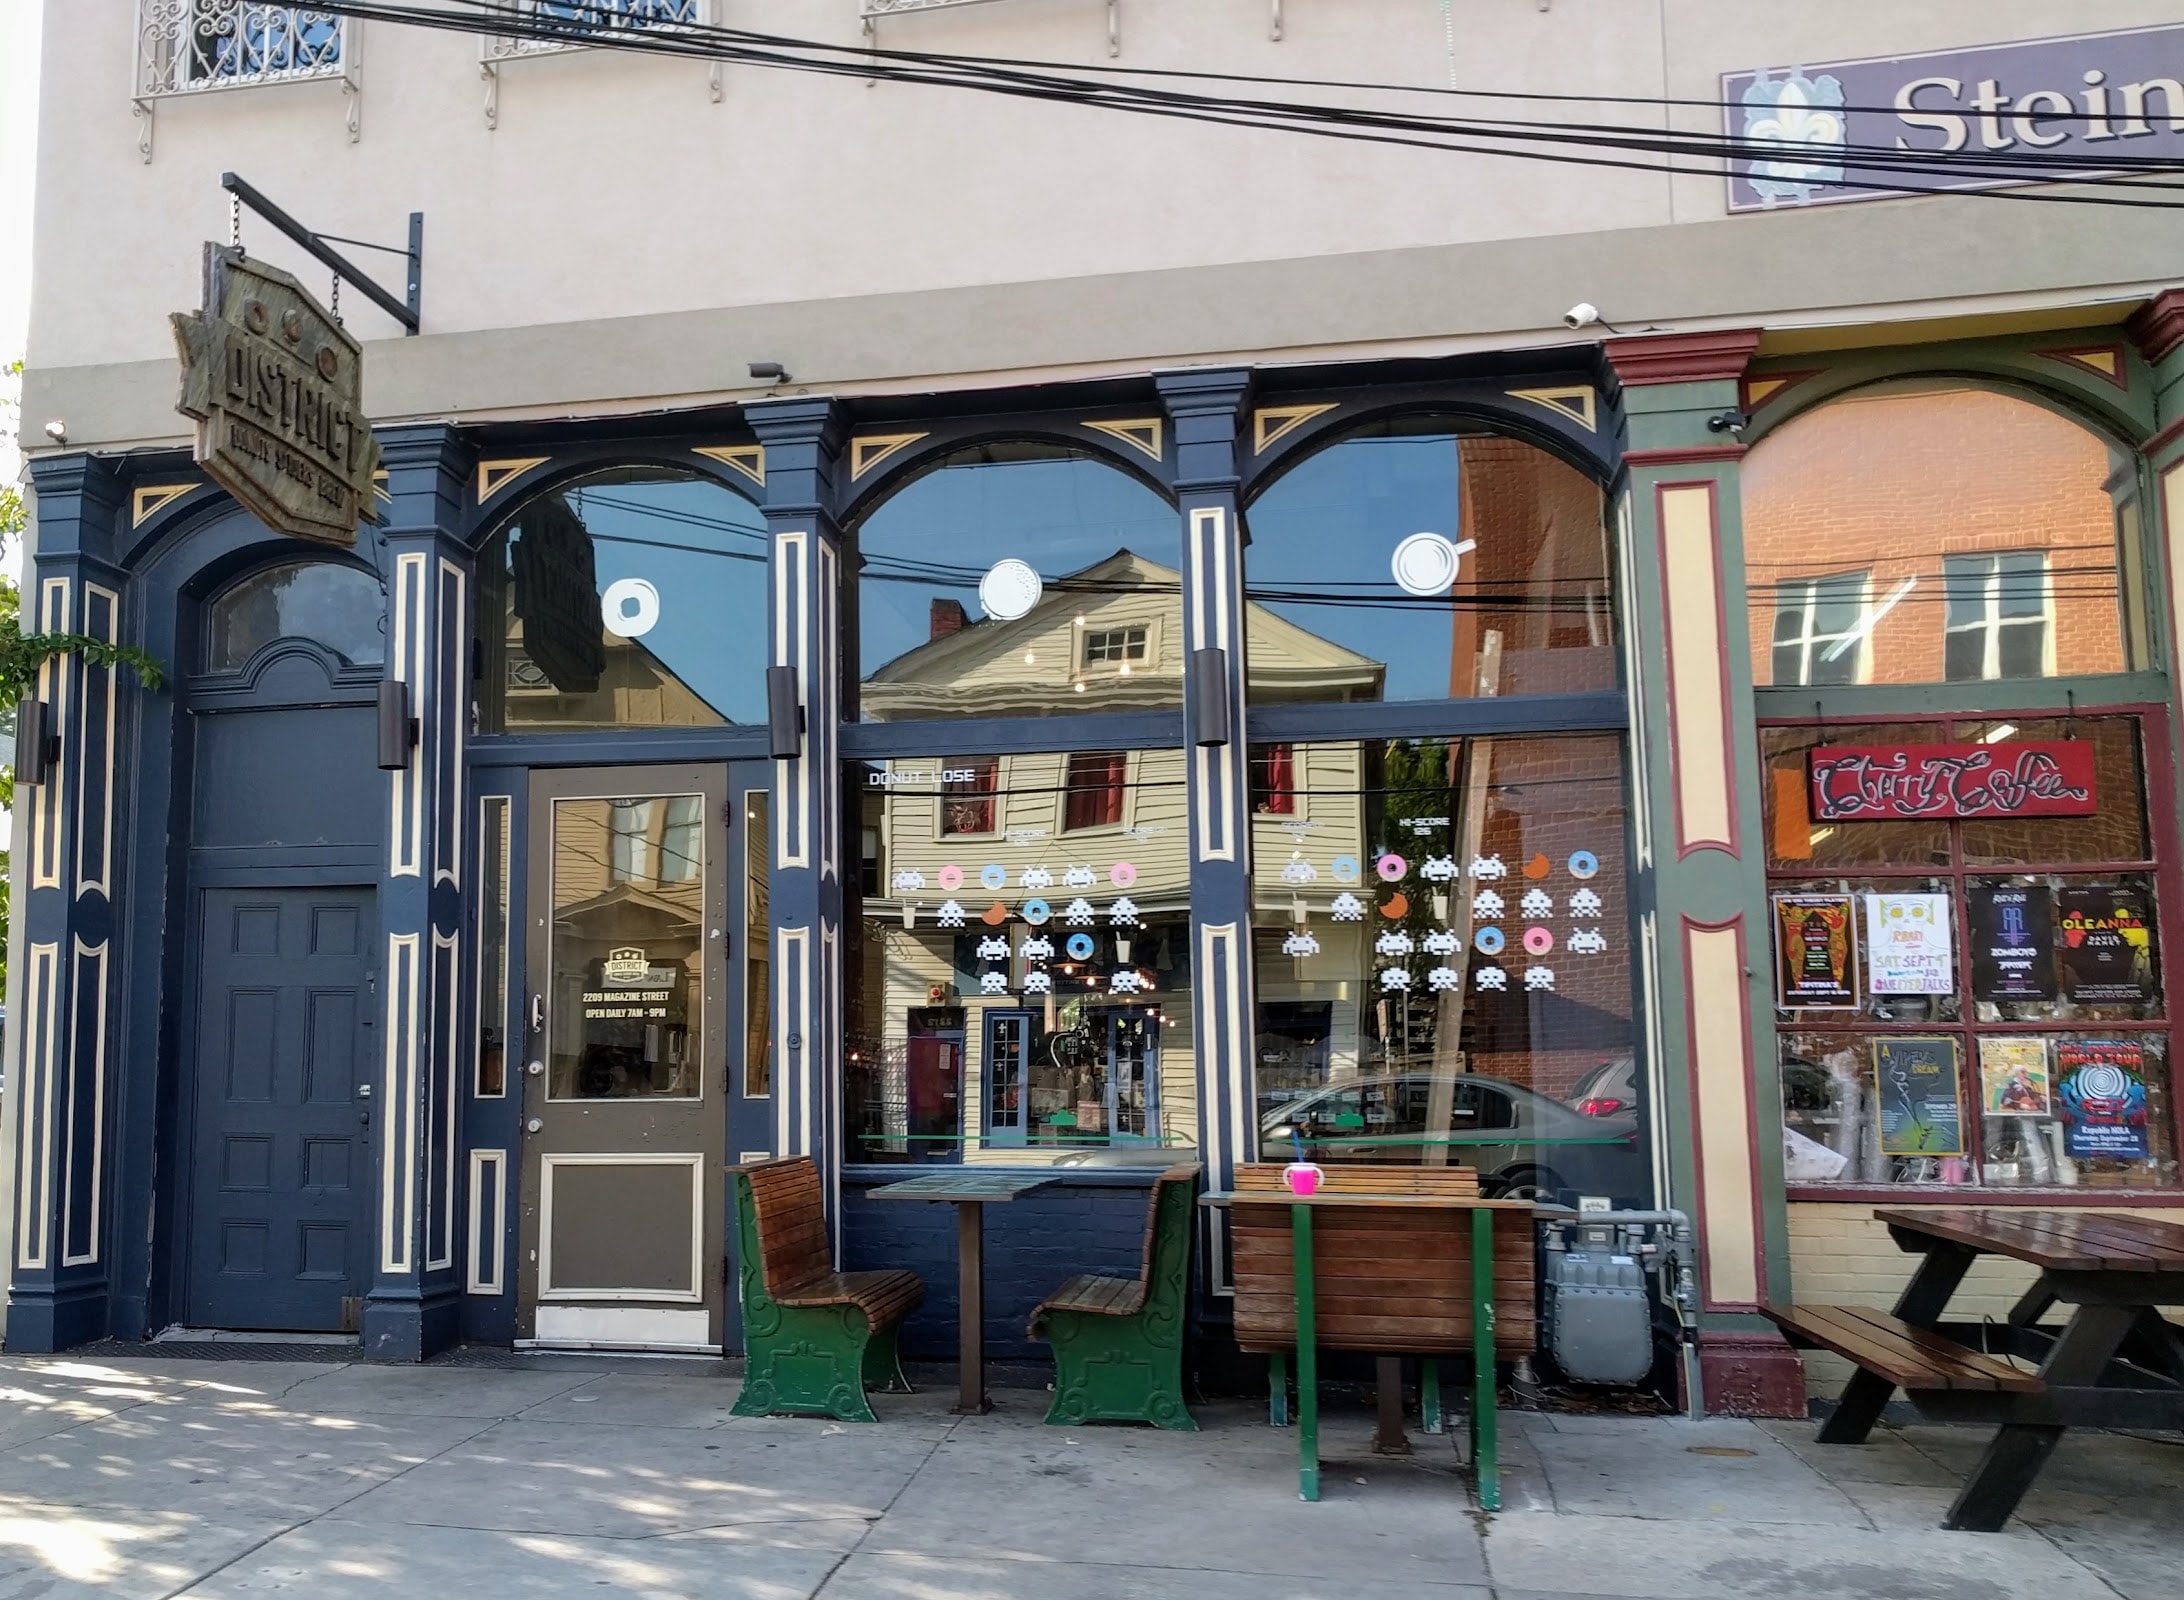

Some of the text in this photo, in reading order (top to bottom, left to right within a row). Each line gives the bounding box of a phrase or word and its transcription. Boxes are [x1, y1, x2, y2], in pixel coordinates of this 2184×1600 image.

[1895, 69, 2184, 154] Stein
[225, 334, 363, 473] DISTRICT
[869, 769, 976, 785] DONUT LOSE
[1922, 750, 2088, 815] Coffee
[1399, 817, 1451, 826] HI-SCORE
[2062, 918, 2143, 930] OLEANNA
[611, 961, 643, 971] DISTRICT
[1875, 955, 1902, 968] SAT
[1902, 955, 1936, 968] SEPT
[583, 991, 669, 1002] 2209 MAGAZINE STREET
[586, 1008, 605, 1018] OPEN
[606, 1008, 626, 1018] DAILY
[627, 1008, 643, 1018] 7AM
[649, 1007, 667, 1018] 9PM
[1881, 1043, 1891, 1058] A
[2060, 1053, 2142, 1064] WORLD TOUR
